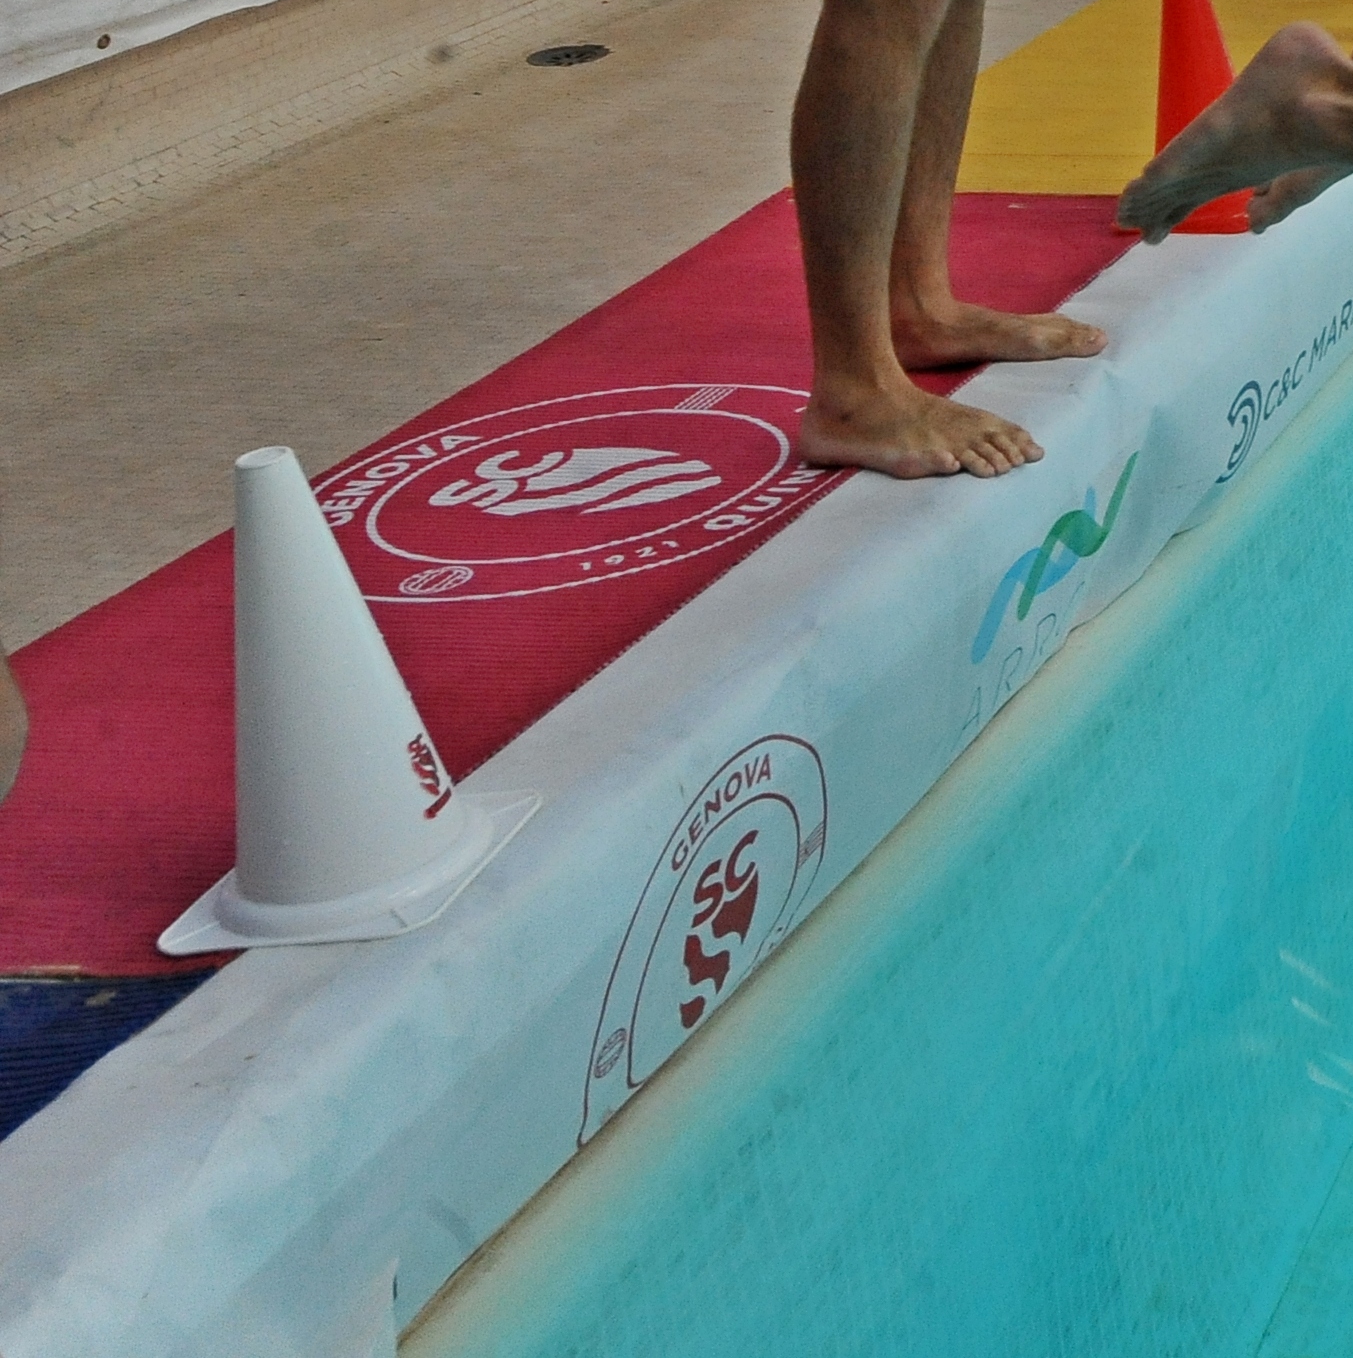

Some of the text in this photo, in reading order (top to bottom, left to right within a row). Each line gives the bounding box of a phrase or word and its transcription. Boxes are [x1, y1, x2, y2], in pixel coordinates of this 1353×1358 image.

[1264, 350, 1307, 422] C&C
[429, 450, 565, 508] SC
[579, 540, 679, 571] 1921
[671, 753, 771, 872] GENOVA
[692, 830, 759, 928] SC
